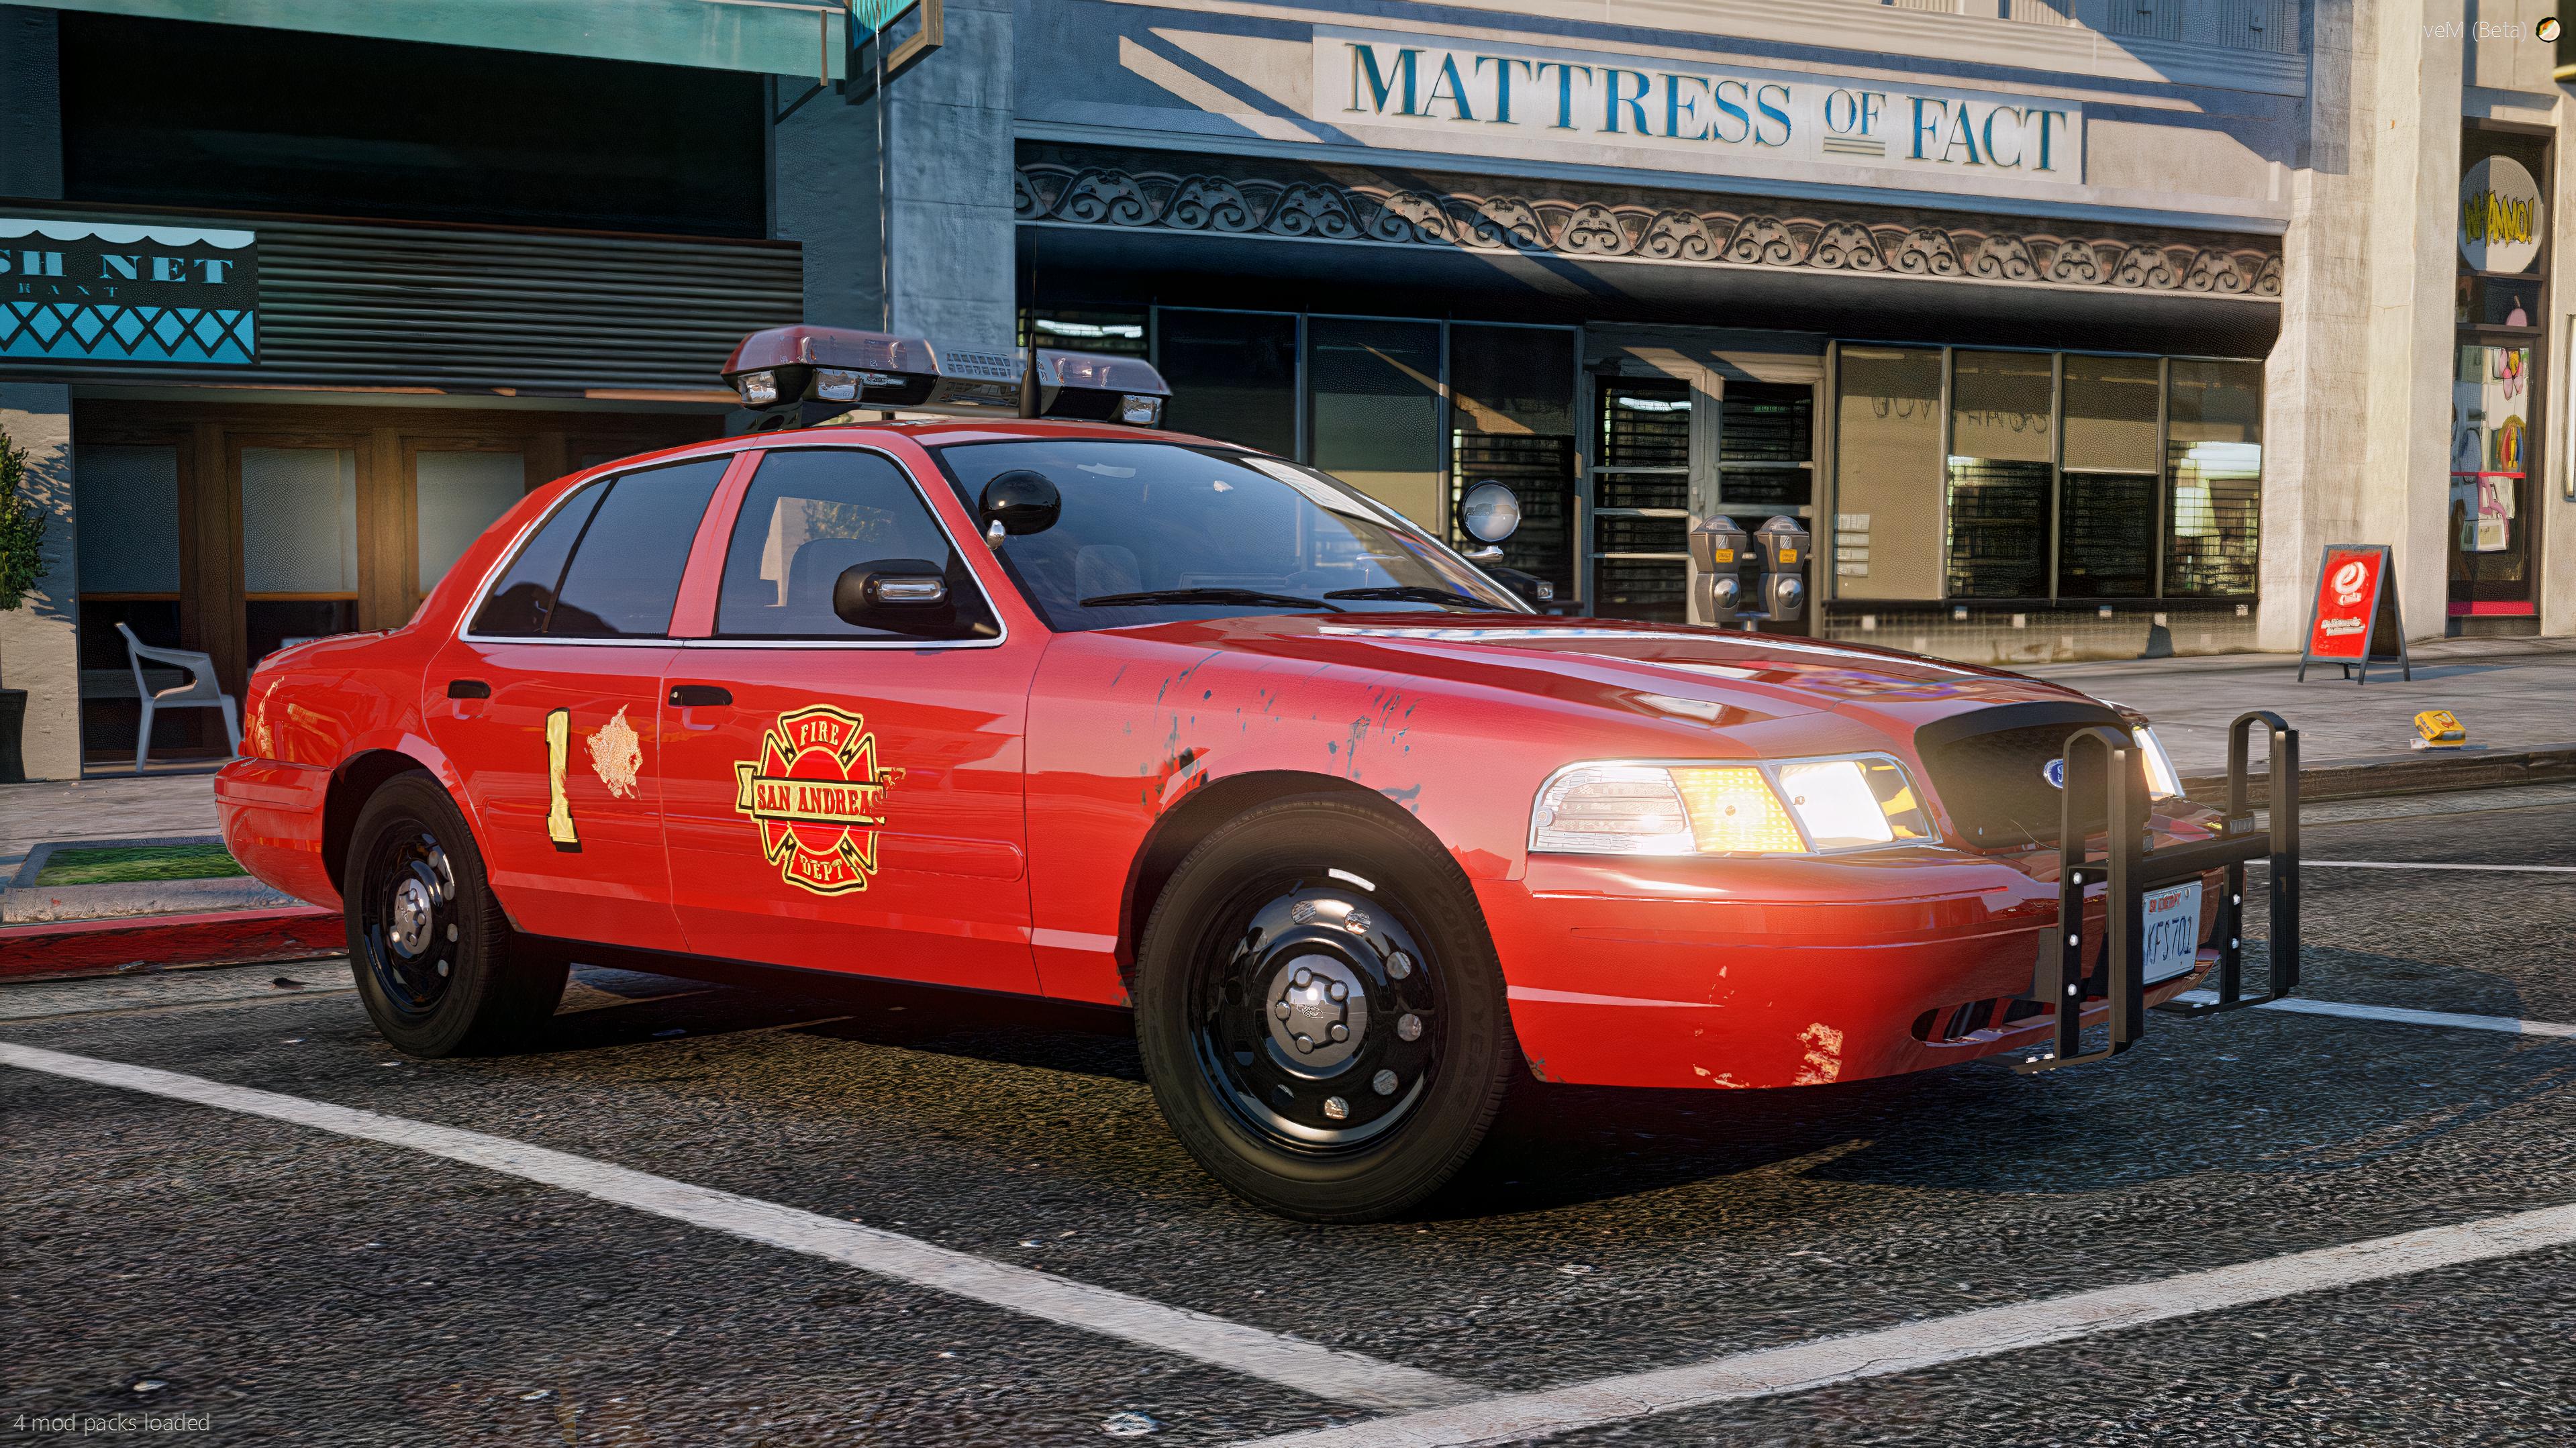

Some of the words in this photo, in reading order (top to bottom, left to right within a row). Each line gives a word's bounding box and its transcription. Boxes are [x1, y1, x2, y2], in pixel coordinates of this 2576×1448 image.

[1343, 42, 1792, 147] MATTRESS
[1824, 89, 1887, 136] OF
[1905, 95, 2068, 172] FACT
[99, 254, 233, 284] NET
[799, 721, 840, 747] FIRE
[546, 707, 580, 849] 1
[756, 784, 791, 812] SAN
[797, 853, 844, 881] DEPT
